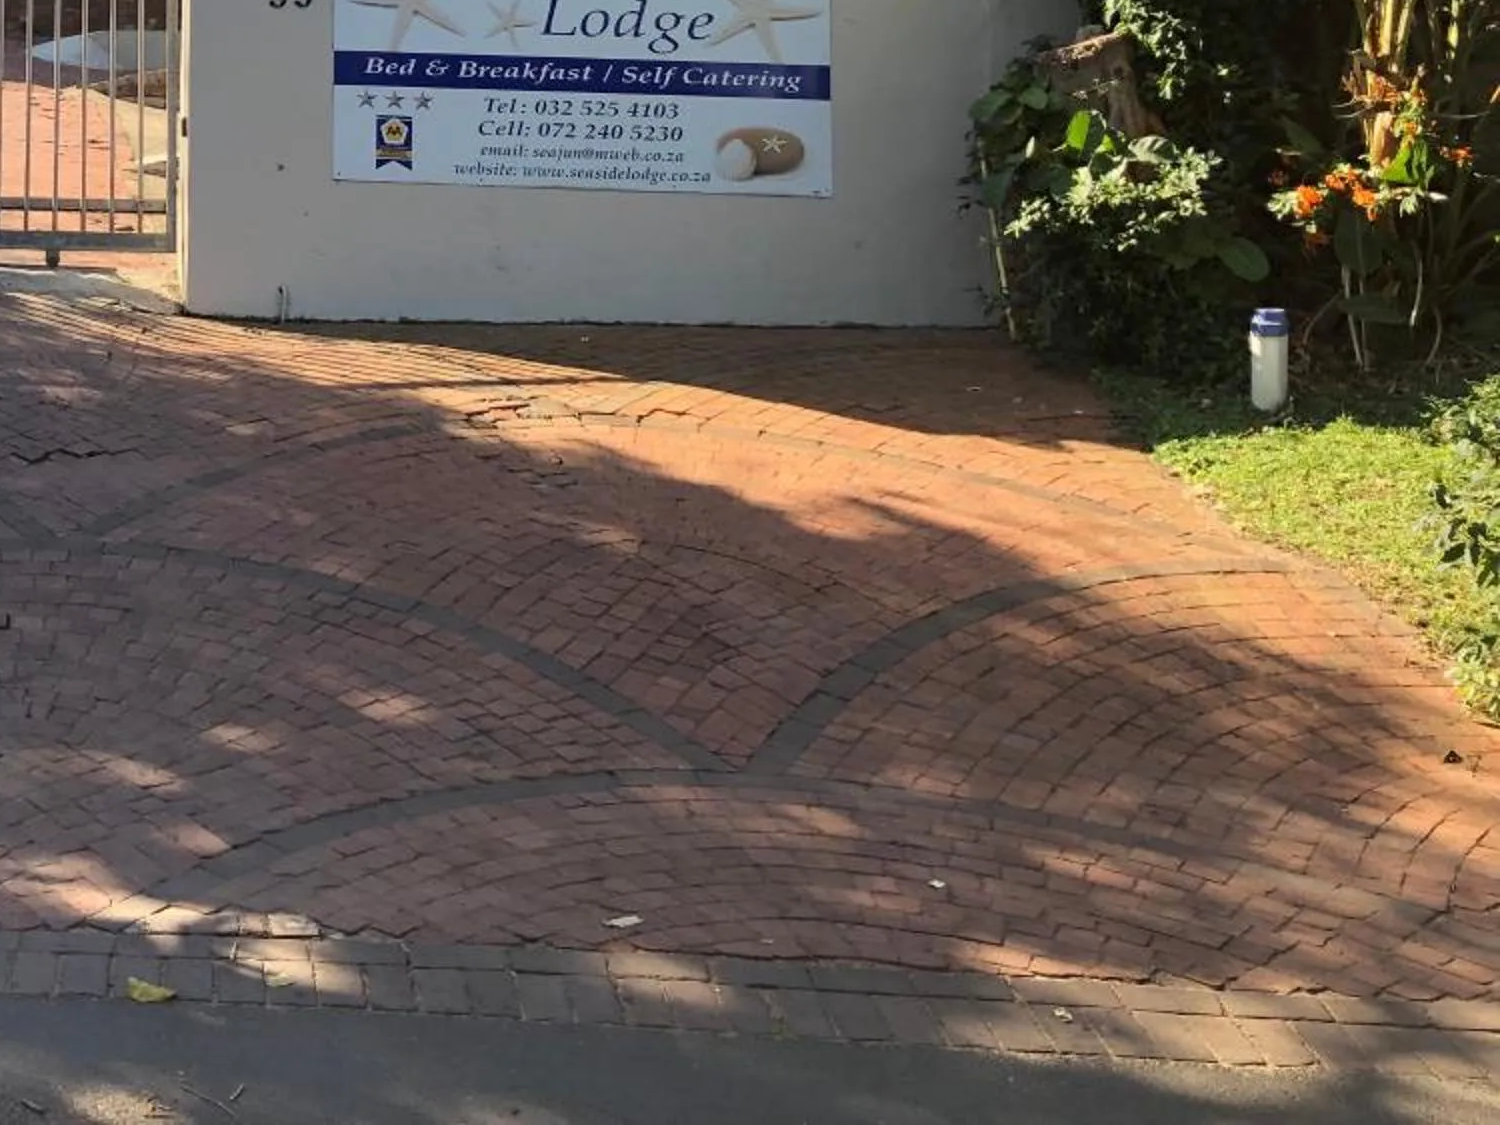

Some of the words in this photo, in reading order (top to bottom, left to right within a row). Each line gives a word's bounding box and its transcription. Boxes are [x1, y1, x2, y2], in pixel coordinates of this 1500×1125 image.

[364, 56, 417, 76] Bed
[425, 59, 449, 76] &
[457, 59, 593, 86] Breakfast
[621, 66, 678, 90] Self
[683, 66, 802, 93] Catering
[534, 99, 574, 117] 032
[579, 101, 620, 118] 525
[626, 102, 680, 120] 4103
[477, 120, 531, 138] Cell:
[537, 122, 577, 140] 072
[583, 124, 624, 141] 240
[629, 125, 684, 142] 5230
[480, 144, 530, 159] email:
[453, 160, 518, 177] website:
[522, 164, 712, 186] www.seasidelodge.co.za
